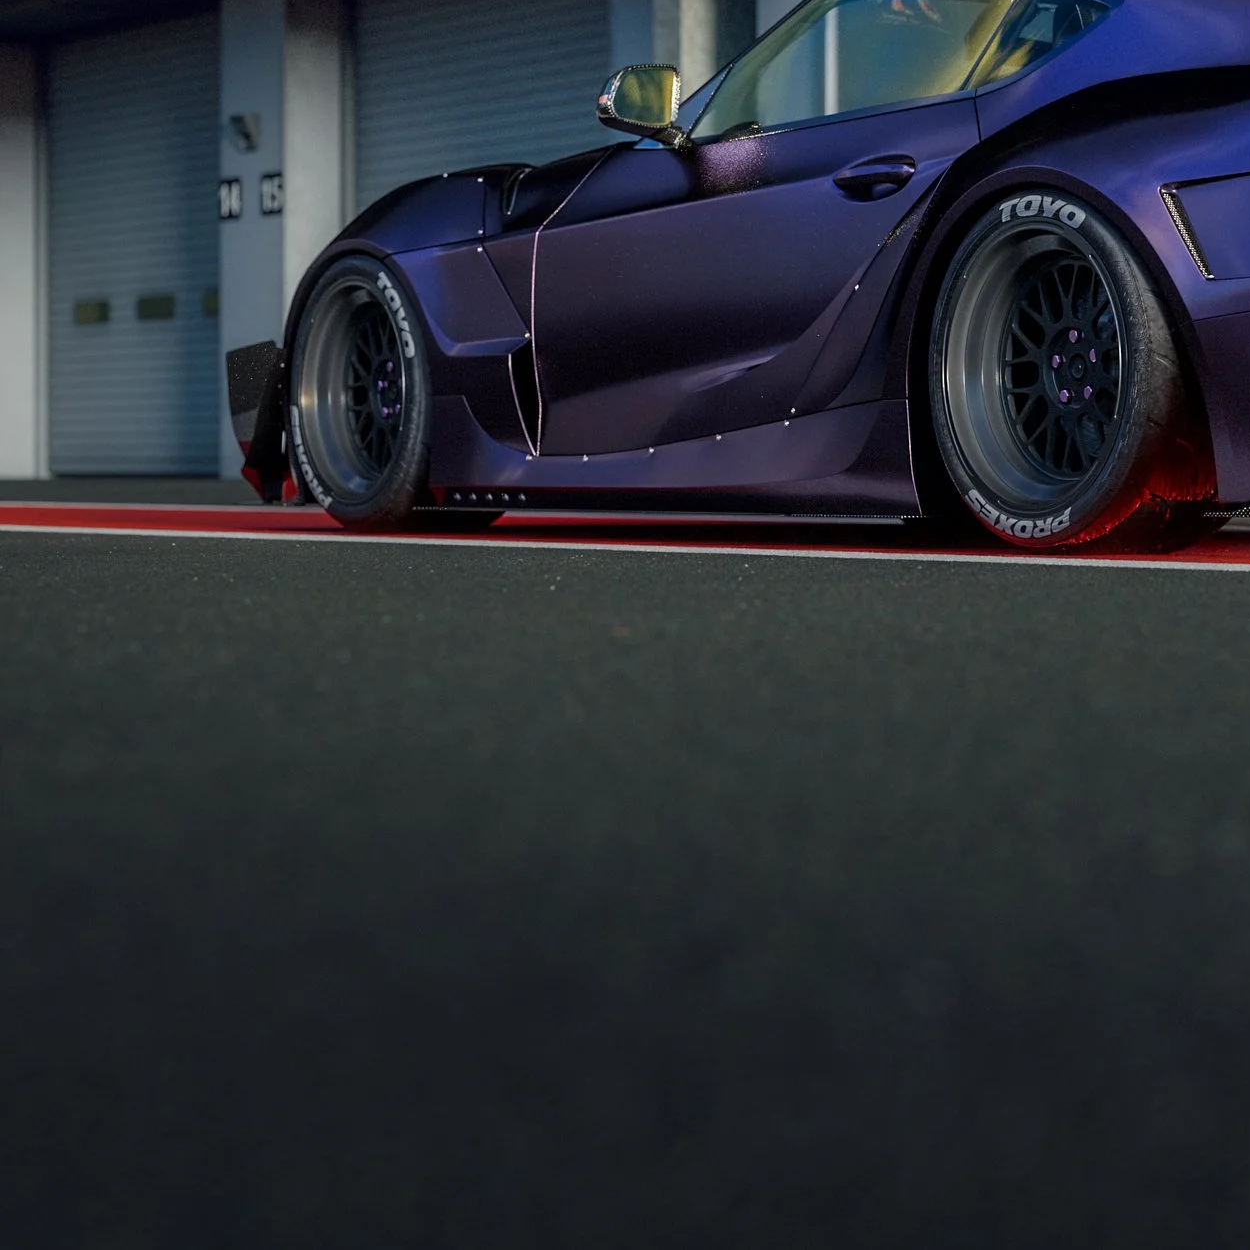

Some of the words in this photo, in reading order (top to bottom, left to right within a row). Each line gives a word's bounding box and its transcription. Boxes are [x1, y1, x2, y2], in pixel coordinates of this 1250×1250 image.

[999, 194, 1087, 229] TOYO
[376, 271, 415, 358] TOYO
[965, 489, 1072, 538] PROXES
